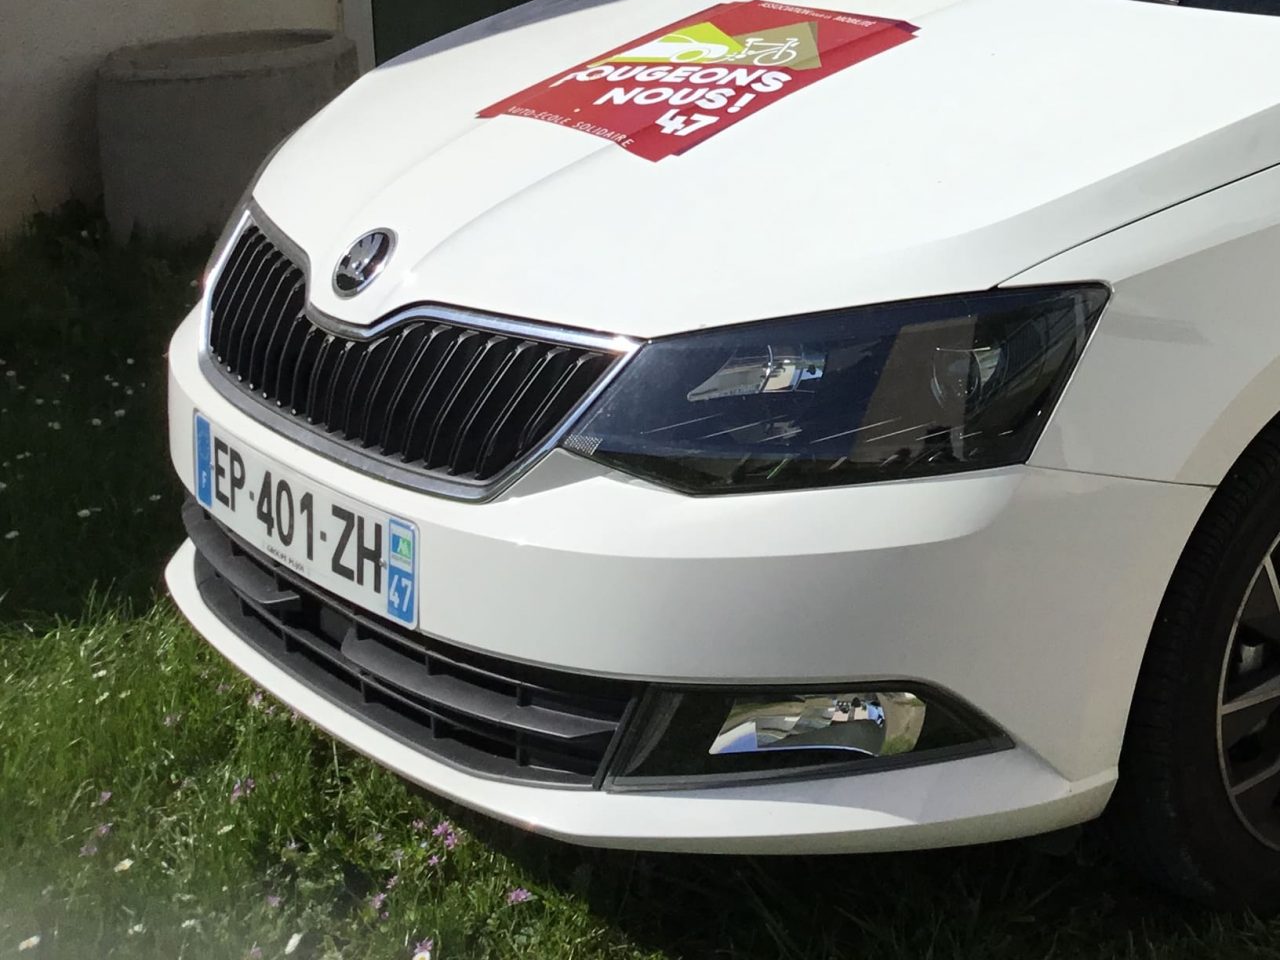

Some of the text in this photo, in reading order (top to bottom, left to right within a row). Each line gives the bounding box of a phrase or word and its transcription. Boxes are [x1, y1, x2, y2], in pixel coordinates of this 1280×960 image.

[572, 120, 635, 148] SOLIDAIRE
[655, 108, 720, 136] 47
[389, 574, 413, 613] 47
